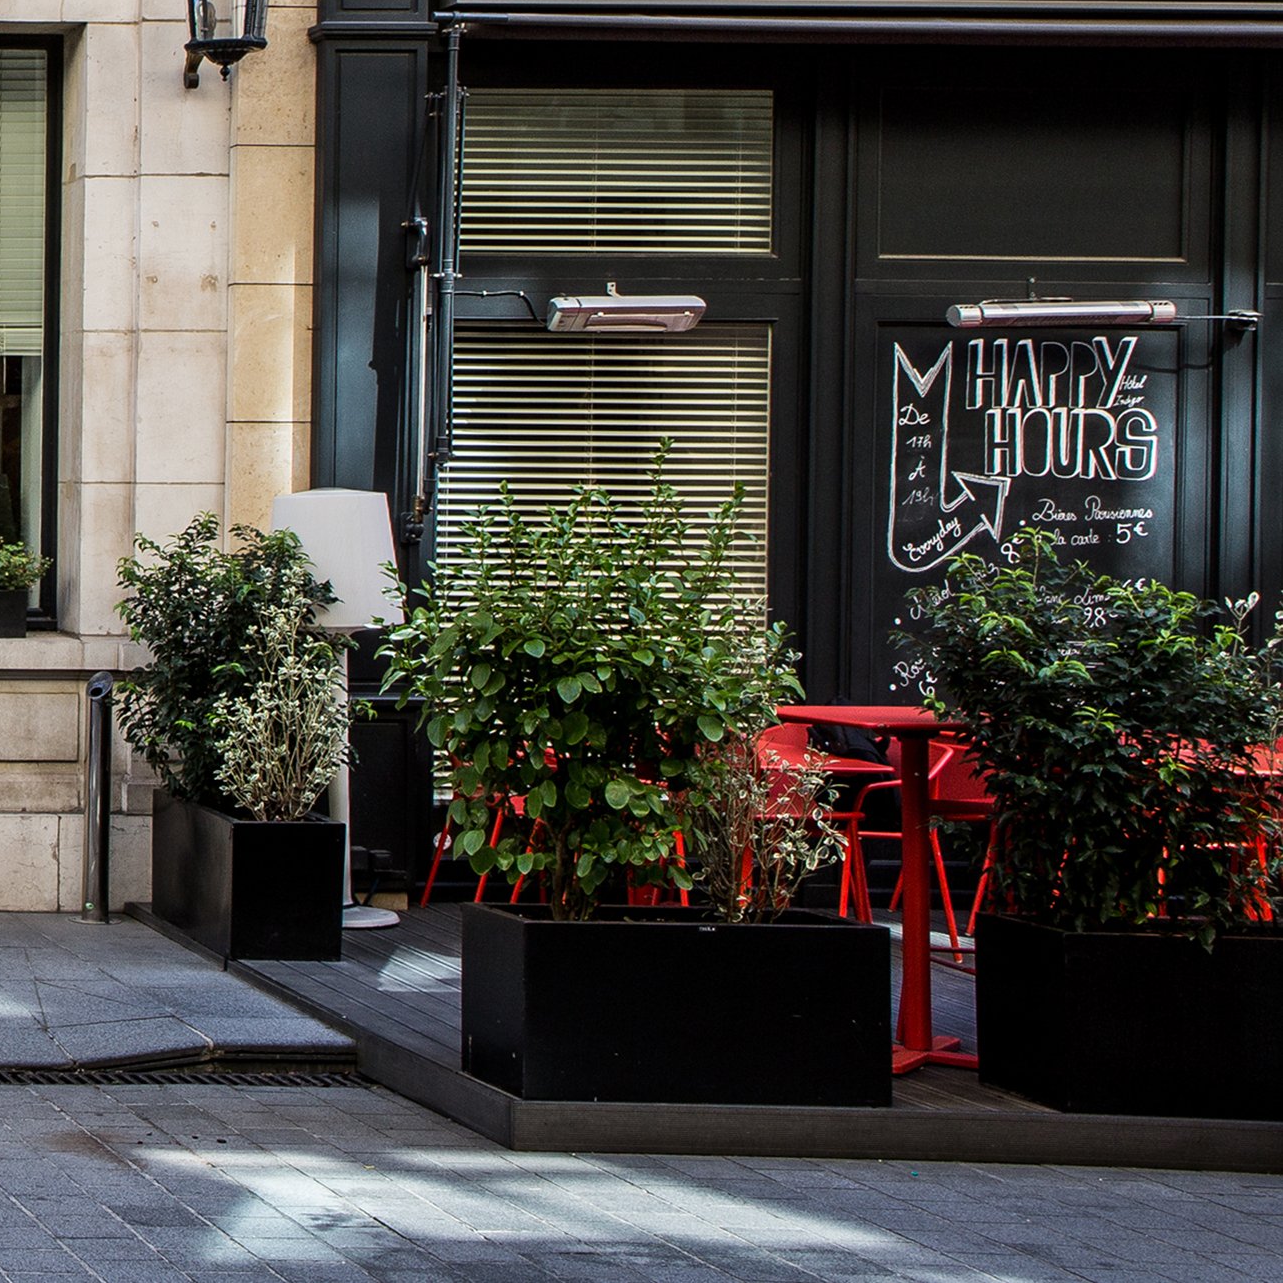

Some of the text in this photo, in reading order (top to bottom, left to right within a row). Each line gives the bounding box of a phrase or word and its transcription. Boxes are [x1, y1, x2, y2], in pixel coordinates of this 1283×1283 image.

[965, 336, 1138, 410] HAPPY
[898, 403, 931, 426] De
[906, 434, 932, 449] 17h
[984, 406, 1159, 481] HOURS
[902, 517, 962, 562] Everyday
[1070, 528, 1101, 547] carte
[1116, 520, 1149, 545] 5€
